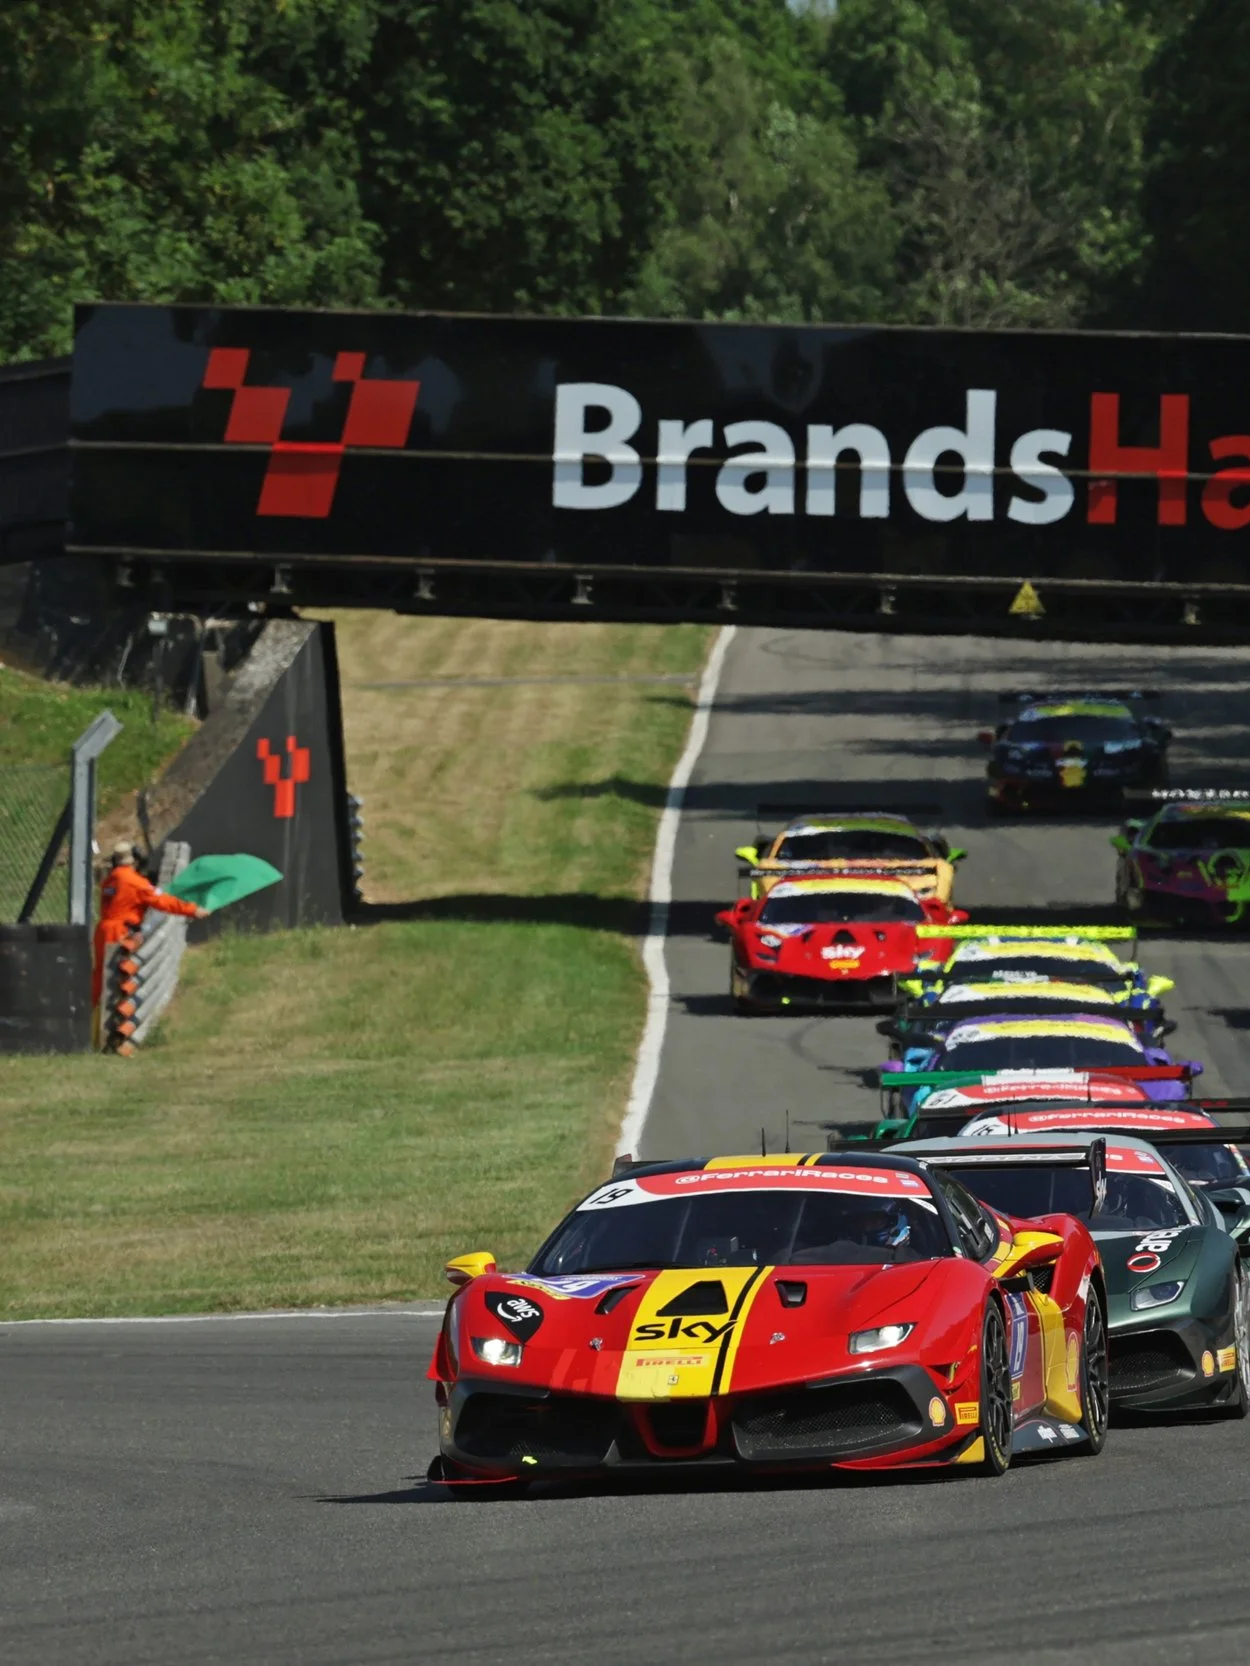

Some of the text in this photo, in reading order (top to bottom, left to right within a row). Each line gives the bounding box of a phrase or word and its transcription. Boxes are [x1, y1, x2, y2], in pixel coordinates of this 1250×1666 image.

[820, 944, 867, 959] sky
[675, 1169, 889, 1185] @FerrariRaces
[589, 1188, 634, 1206] 19
[506, 1298, 541, 1318] aws
[633, 1317, 739, 1344] sky
